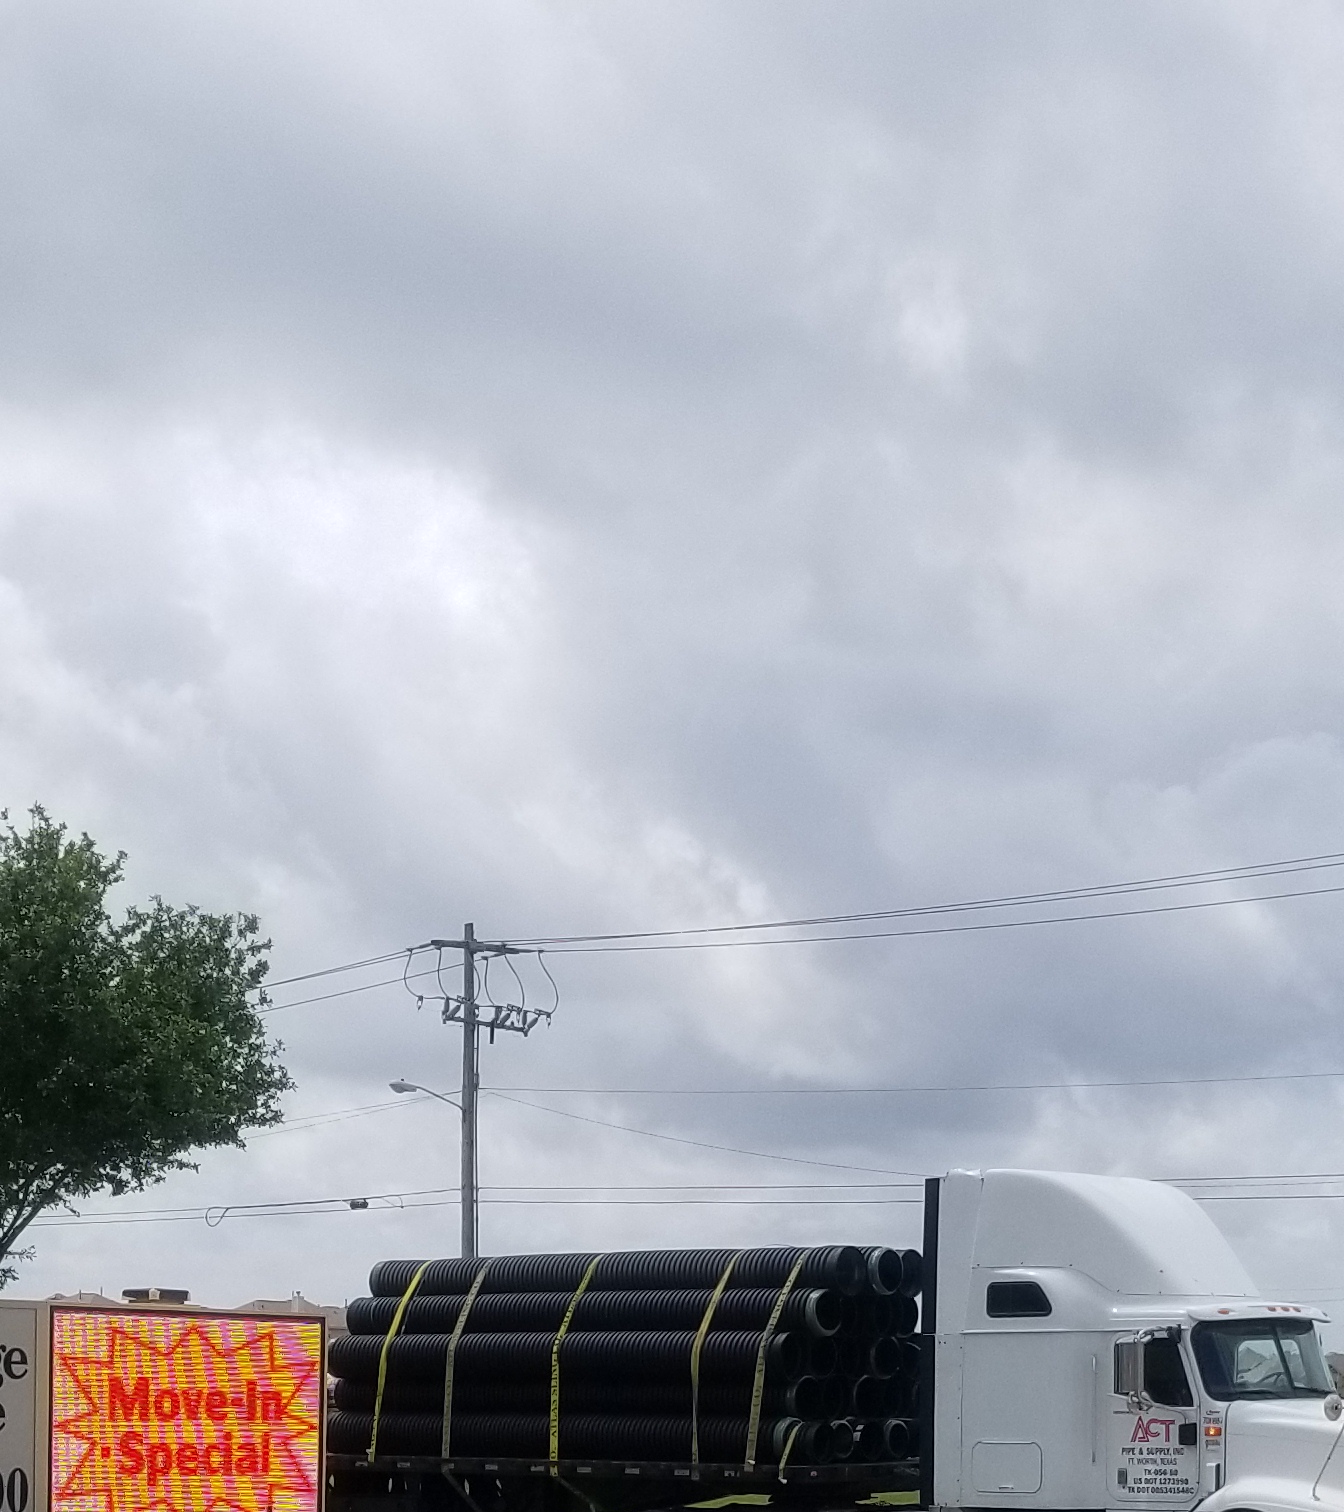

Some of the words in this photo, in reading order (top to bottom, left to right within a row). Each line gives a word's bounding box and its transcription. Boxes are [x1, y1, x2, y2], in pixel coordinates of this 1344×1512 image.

[1131, 1415, 1176, 1442] ACT
[1121, 1447, 1136, 1456] PIPE
[118, 1431, 271, 1487] Special
[1160, 1457, 1178, 1466] TEXAS
[1133, 1477, 1143, 1485] US
[1144, 1477, 1158, 1485] DOT
[1136, 1486, 1151, 1494] DOT
